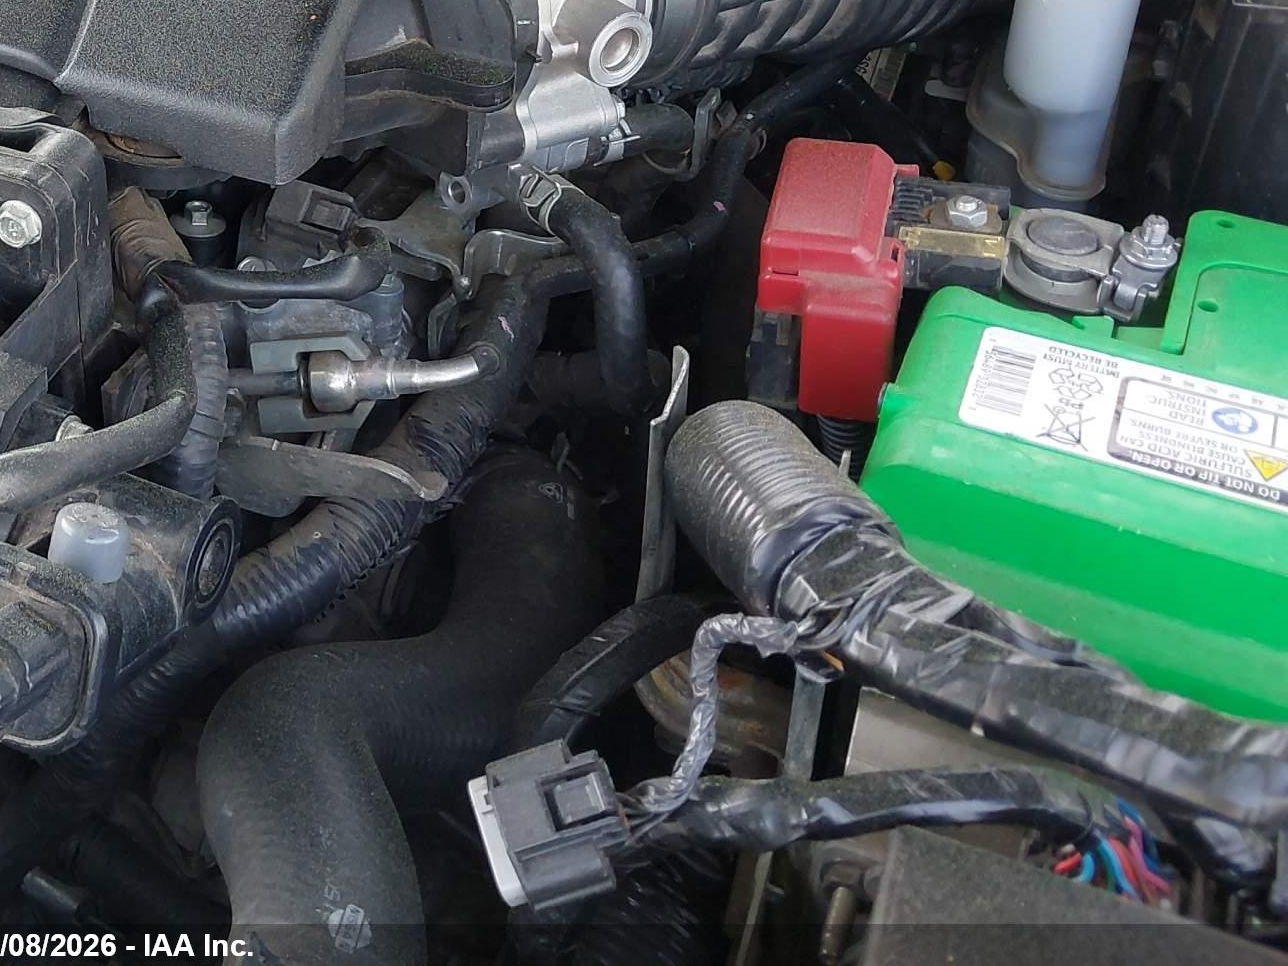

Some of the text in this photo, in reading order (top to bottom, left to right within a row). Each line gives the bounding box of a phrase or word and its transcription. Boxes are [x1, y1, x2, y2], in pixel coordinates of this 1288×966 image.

[1042, 353, 1073, 368] MUST
[1048, 345, 1119, 369] BE RECYCLED
[1168, 410, 1205, 426] READ
[1175, 430, 1218, 448] SEVERE
[1139, 430, 1246, 466] CAUSE BLINDNESS
[1220, 442, 1238, 454] OR
[1120, 435, 1253, 479] SULFURIC ACID CAN
[1174, 464, 1196, 477] OR
[1198, 472, 1221, 484] TIP
[1225, 480, 1255, 494] NOT
[1258, 488, 1281, 501] DO
